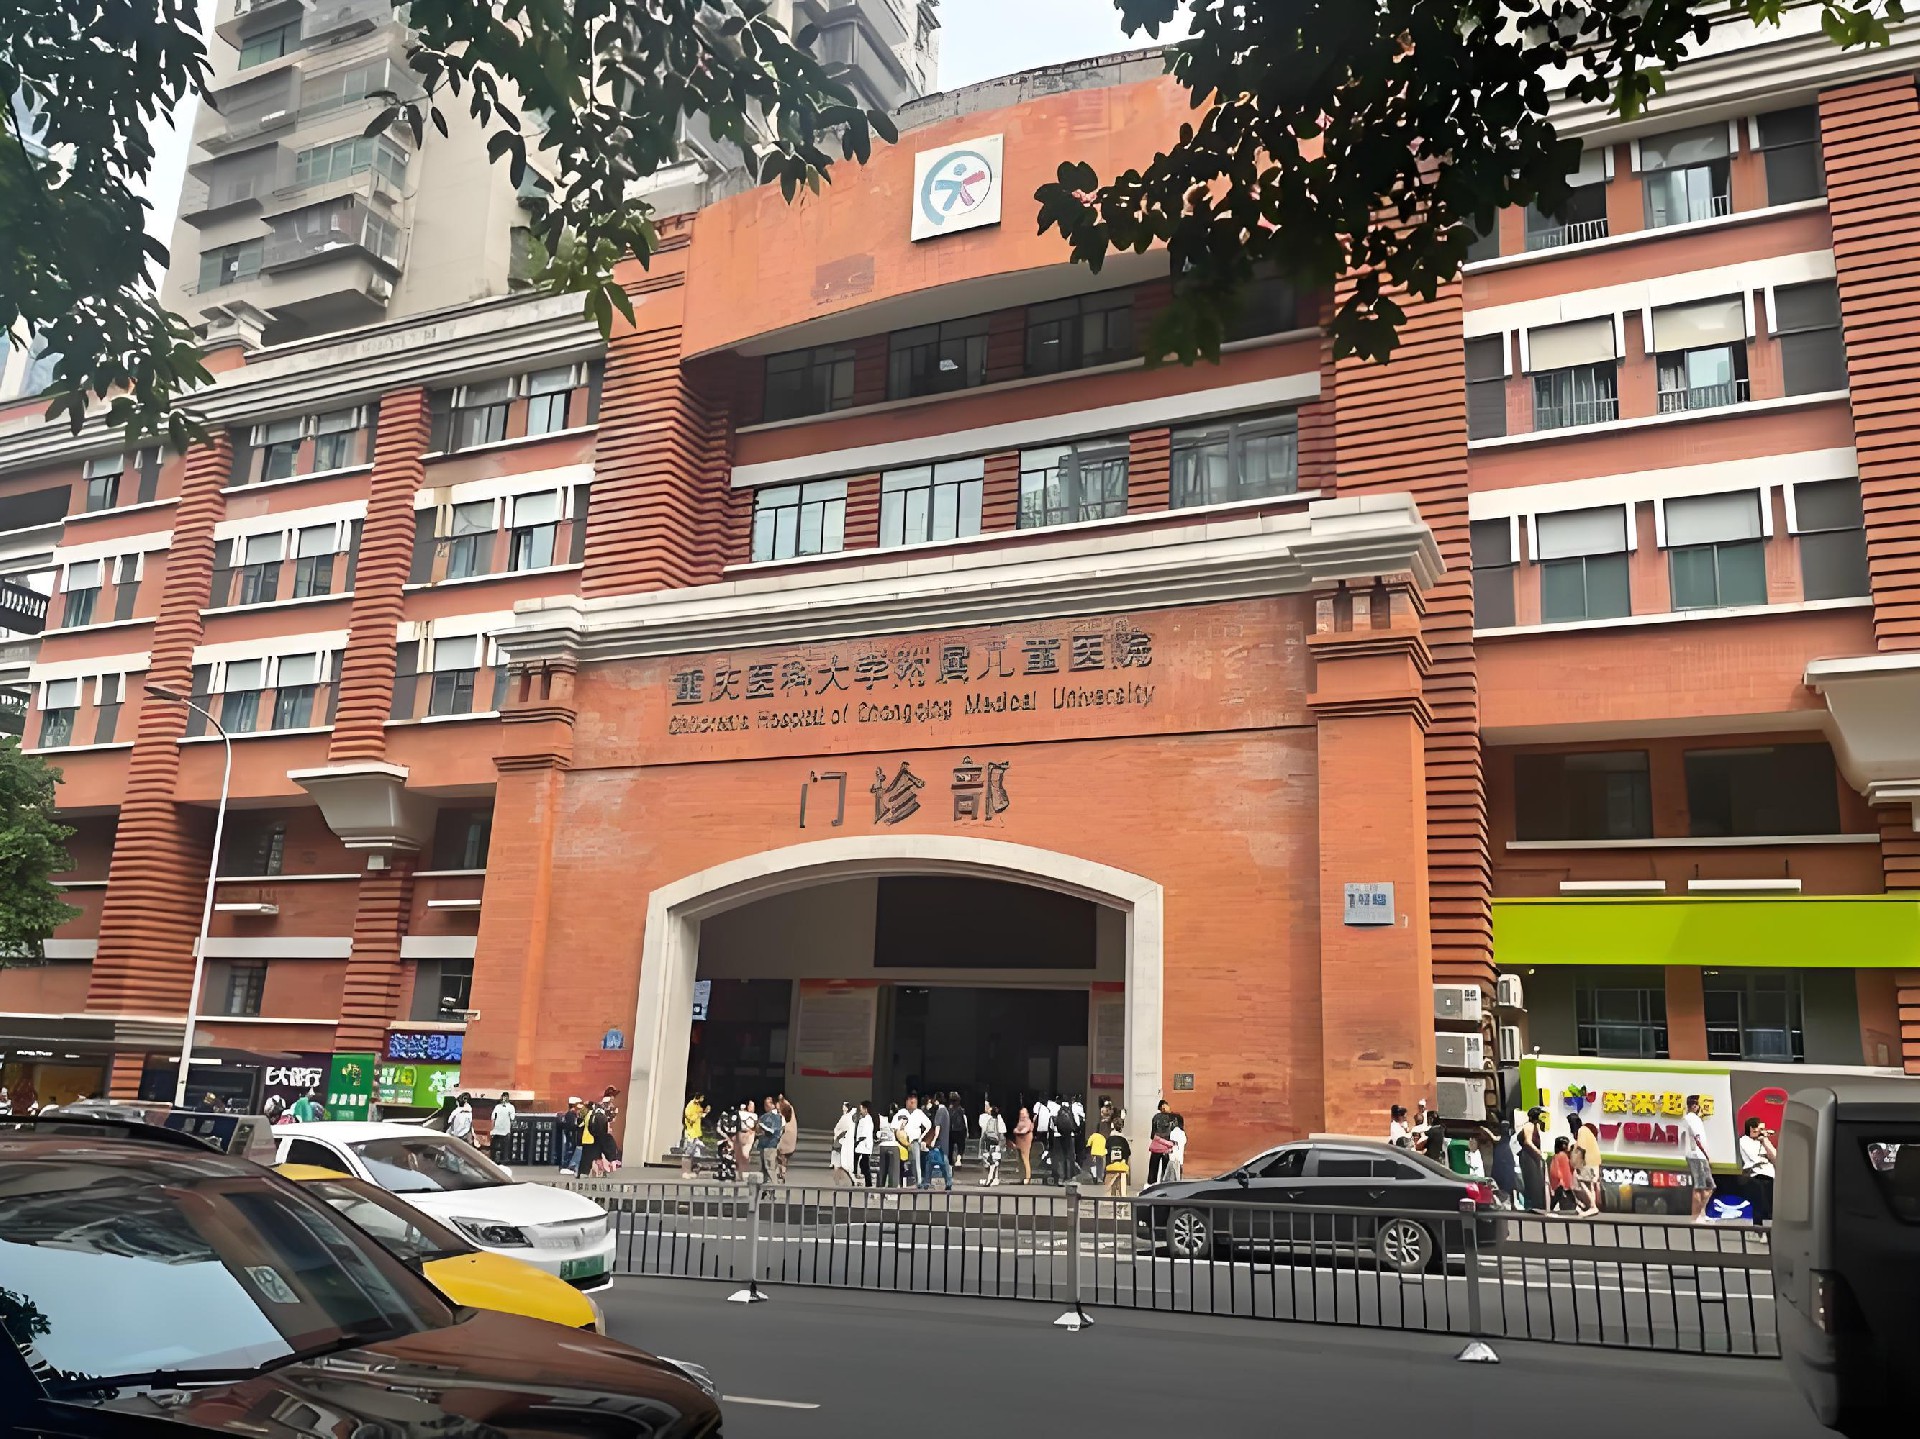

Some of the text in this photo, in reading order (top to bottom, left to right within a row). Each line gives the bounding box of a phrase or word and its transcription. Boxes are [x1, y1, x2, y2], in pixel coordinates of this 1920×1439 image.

[831, 703, 849, 725] of
[800, 756, 1010, 828] 门诊部
